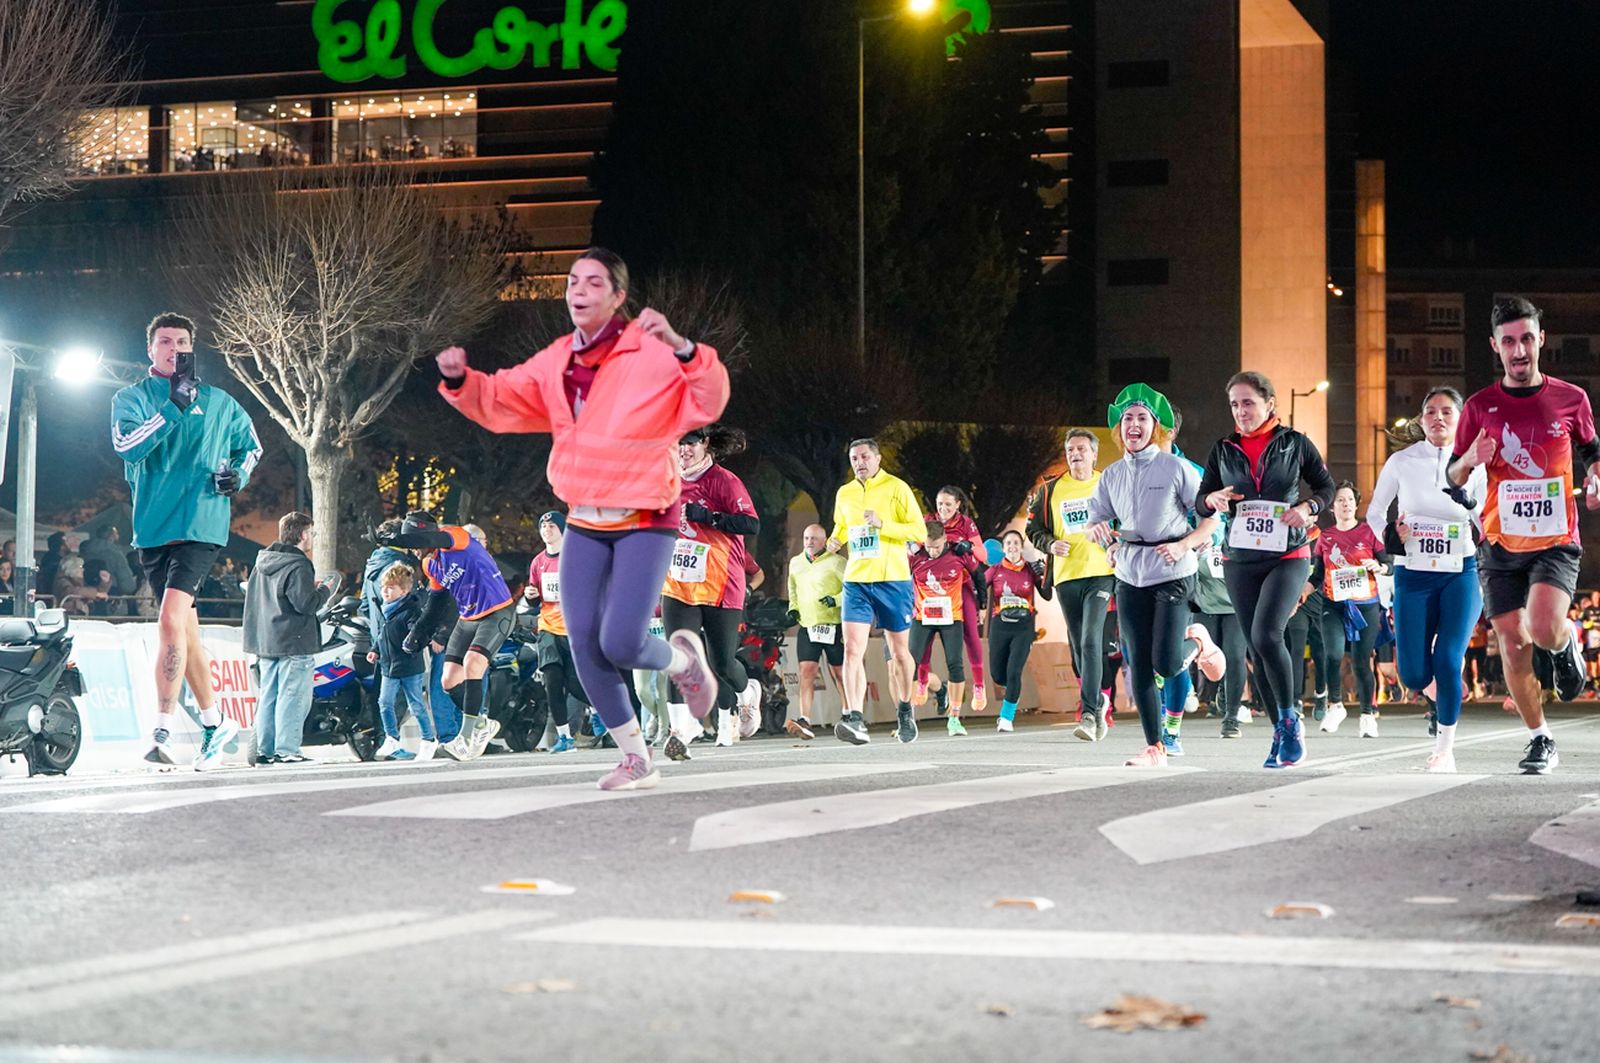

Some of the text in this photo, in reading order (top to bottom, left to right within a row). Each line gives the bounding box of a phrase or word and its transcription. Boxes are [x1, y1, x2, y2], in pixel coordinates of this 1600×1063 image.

[312, 0, 628, 83] El Corte
[1512, 499, 1553, 517] 4378
[1066, 510, 1088, 523] 1321
[1246, 517, 1274, 534] 538
[1418, 538, 1451, 554] 1861
[672, 553, 698, 569] 1582
[1339, 577, 1362, 589] 5165
[209, 659, 248, 692] SAN
